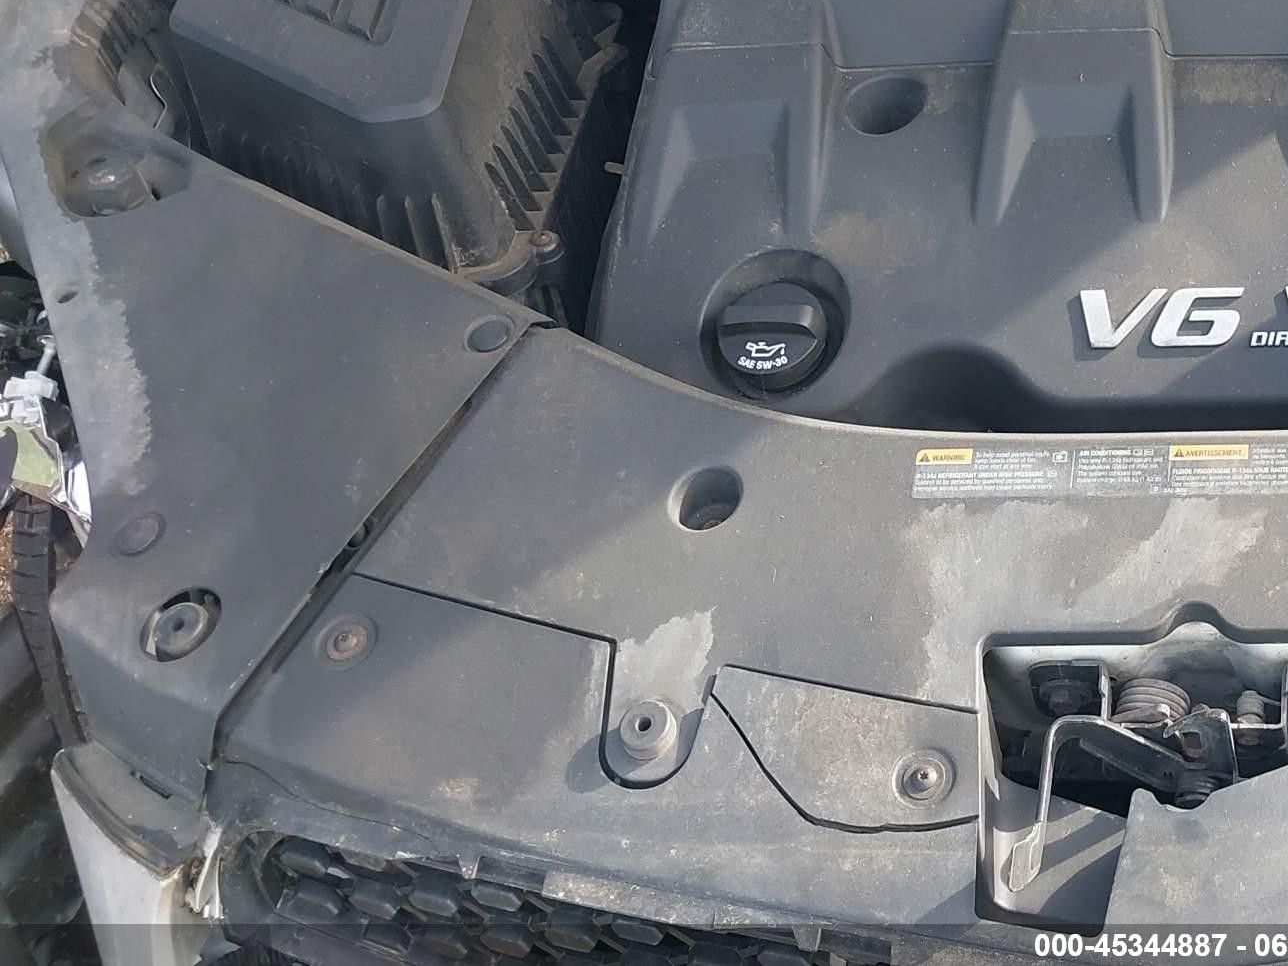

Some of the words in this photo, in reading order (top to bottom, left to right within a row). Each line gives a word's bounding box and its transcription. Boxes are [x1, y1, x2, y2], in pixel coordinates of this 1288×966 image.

[1079, 287, 1245, 348] V6
[737, 356, 756, 369] SAE
[756, 355, 788, 370] 5W-30
[1185, 449, 1242, 457] AVERTISSEMENT
